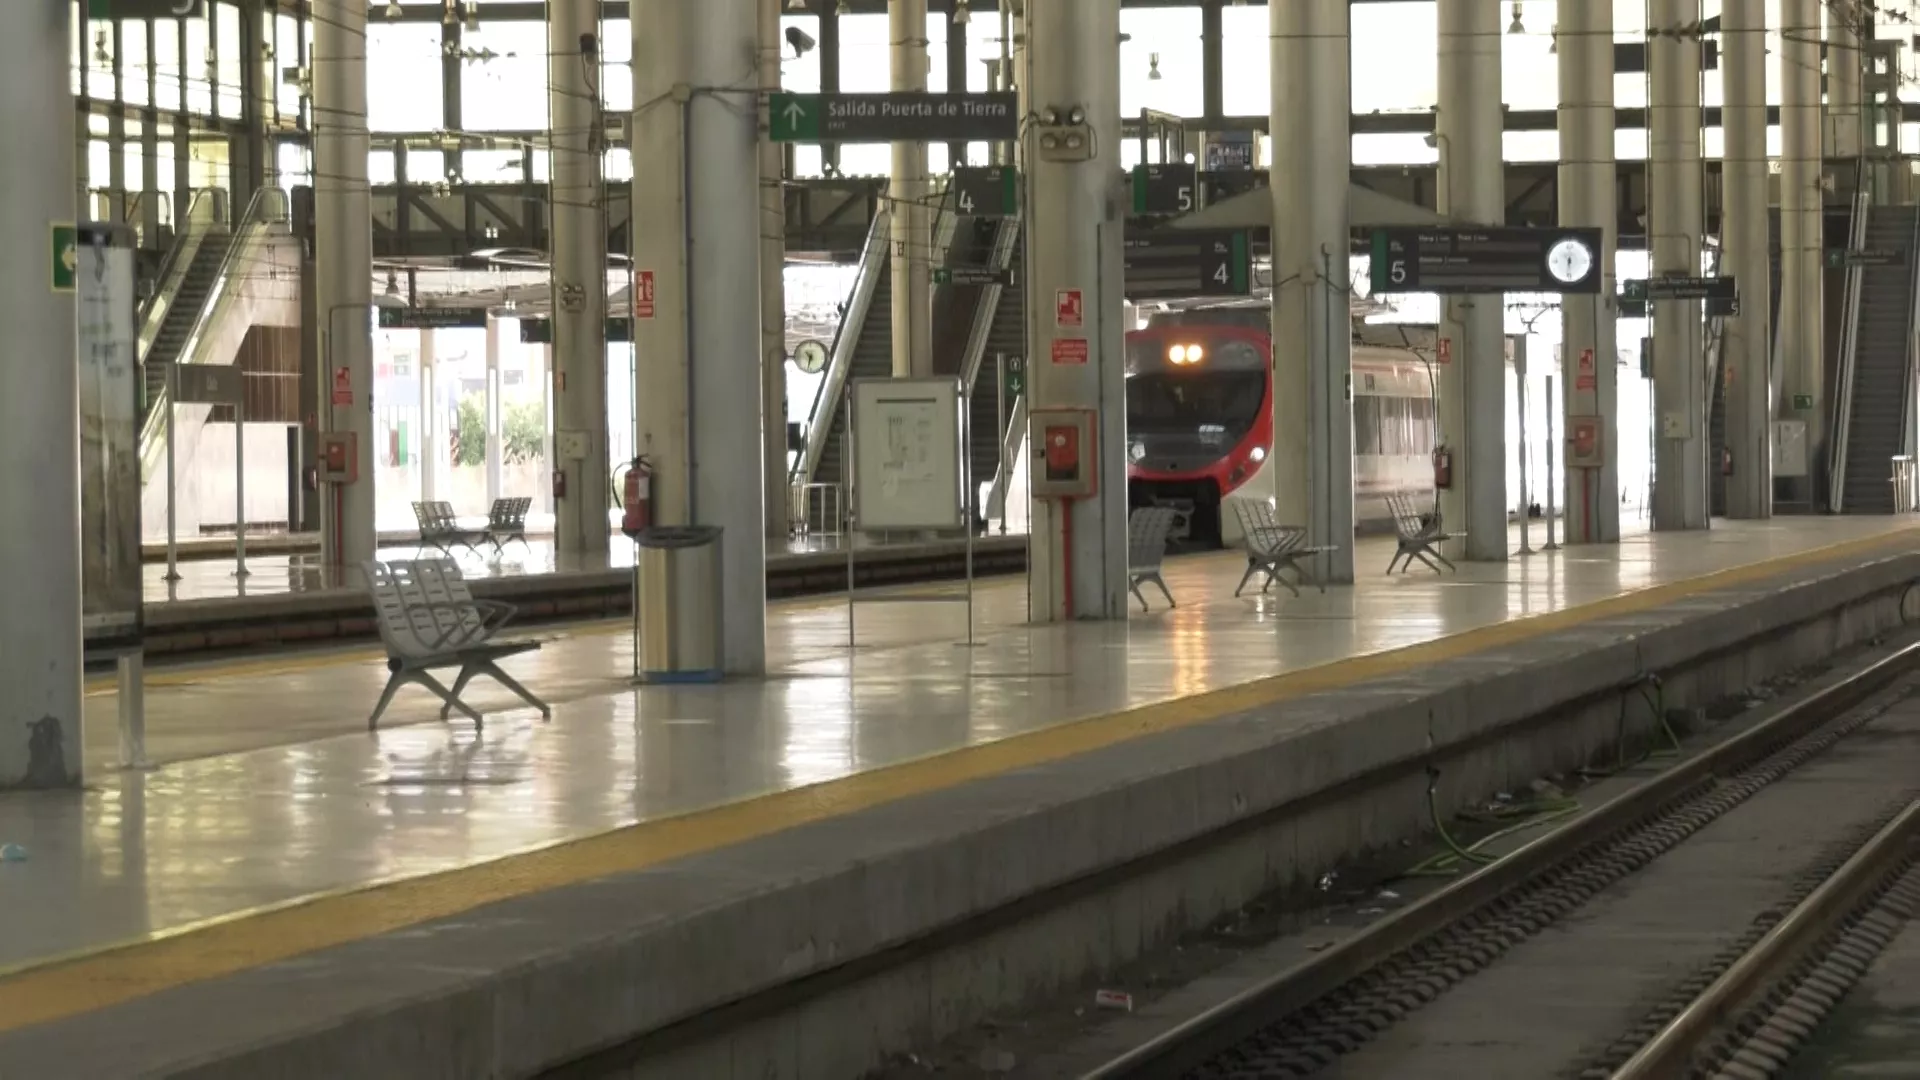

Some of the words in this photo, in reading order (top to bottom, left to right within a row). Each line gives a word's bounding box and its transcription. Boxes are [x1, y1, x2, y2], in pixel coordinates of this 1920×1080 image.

[828, 100, 876, 116] Salida
[881, 101, 932, 118] Puerta
[938, 101, 957, 116] de
[961, 101, 1007, 116] Tierra
[959, 189, 975, 213] 4
[1178, 187, 1191, 211] 5
[1213, 262, 1230, 285] 4
[1391, 260, 1406, 284] 5
